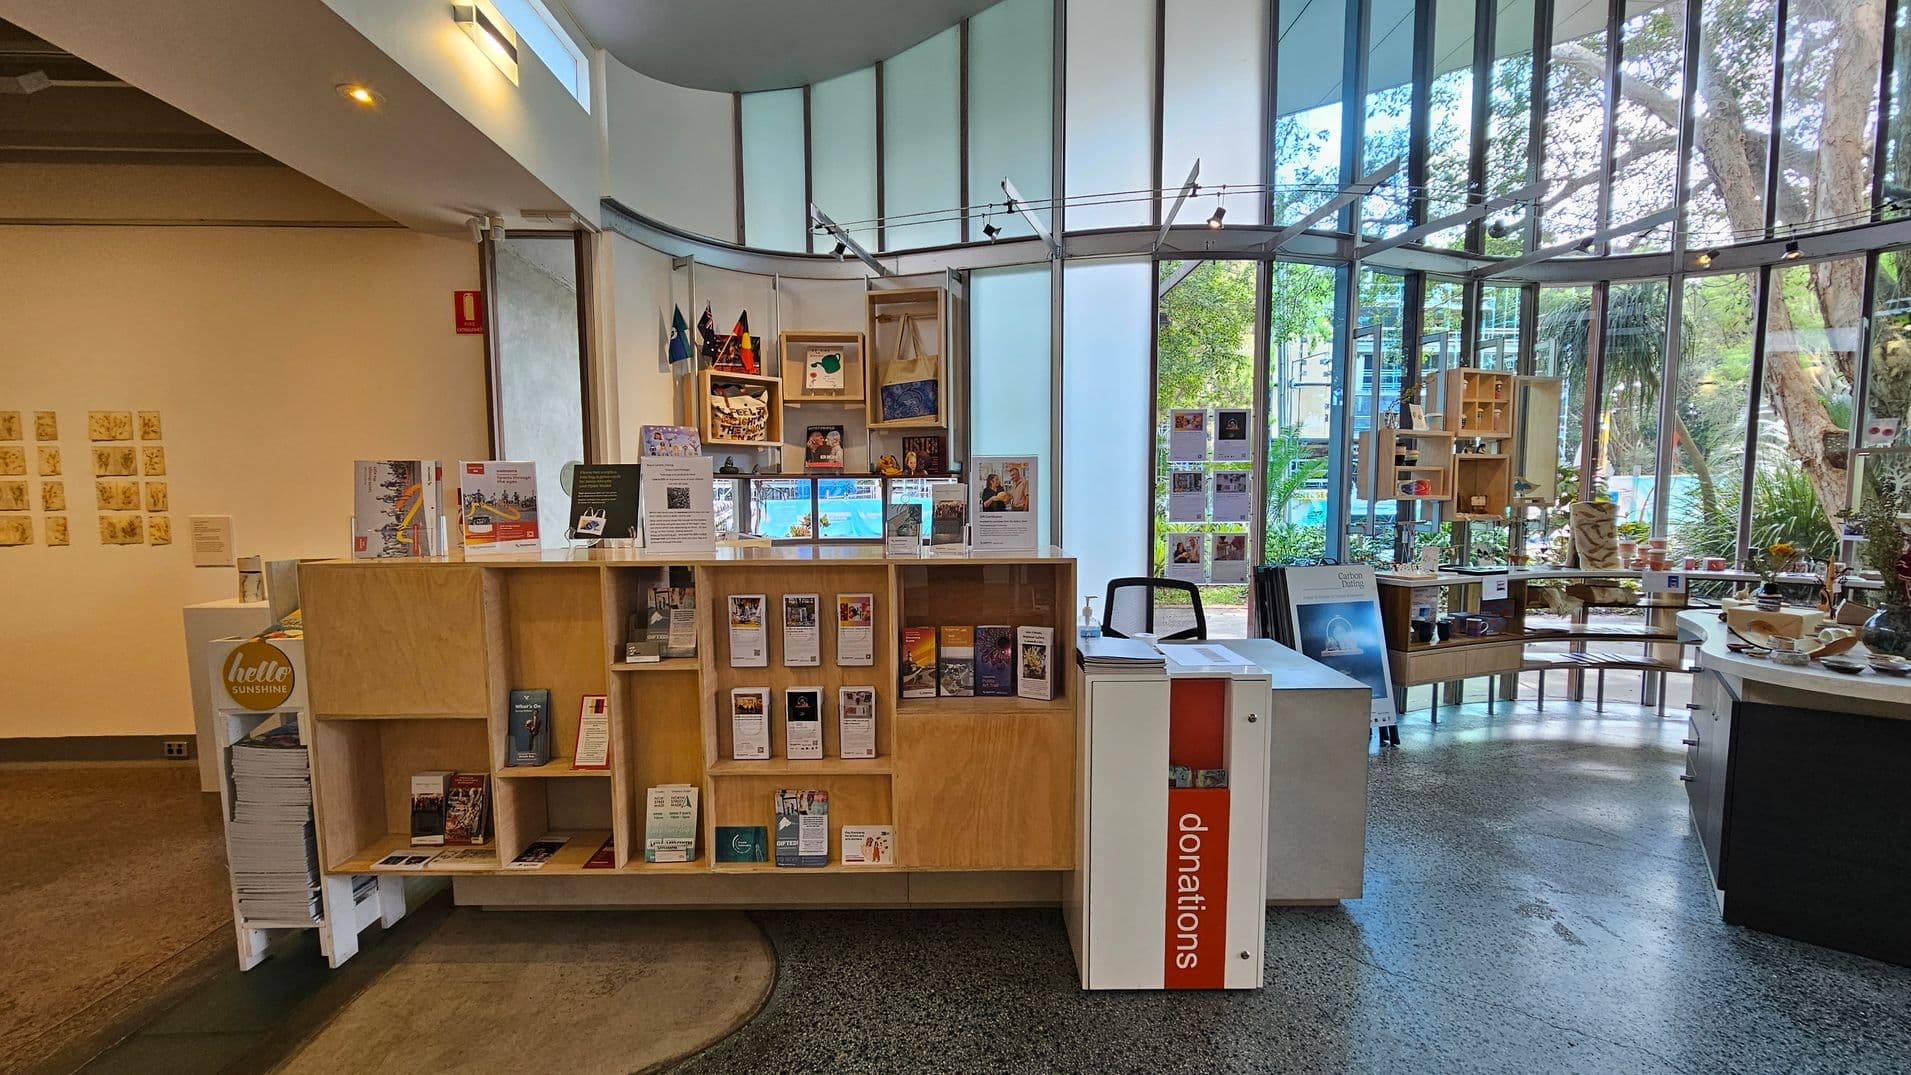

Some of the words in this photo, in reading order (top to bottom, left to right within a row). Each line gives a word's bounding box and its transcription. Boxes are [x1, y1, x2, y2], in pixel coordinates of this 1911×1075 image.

[1338, 572, 1363, 581] Carbon
[1342, 580, 1365, 589] Dating
[228, 652, 291, 683] hello
[232, 684, 288, 694] SUNSHINE
[1176, 812, 1208, 969] donations
